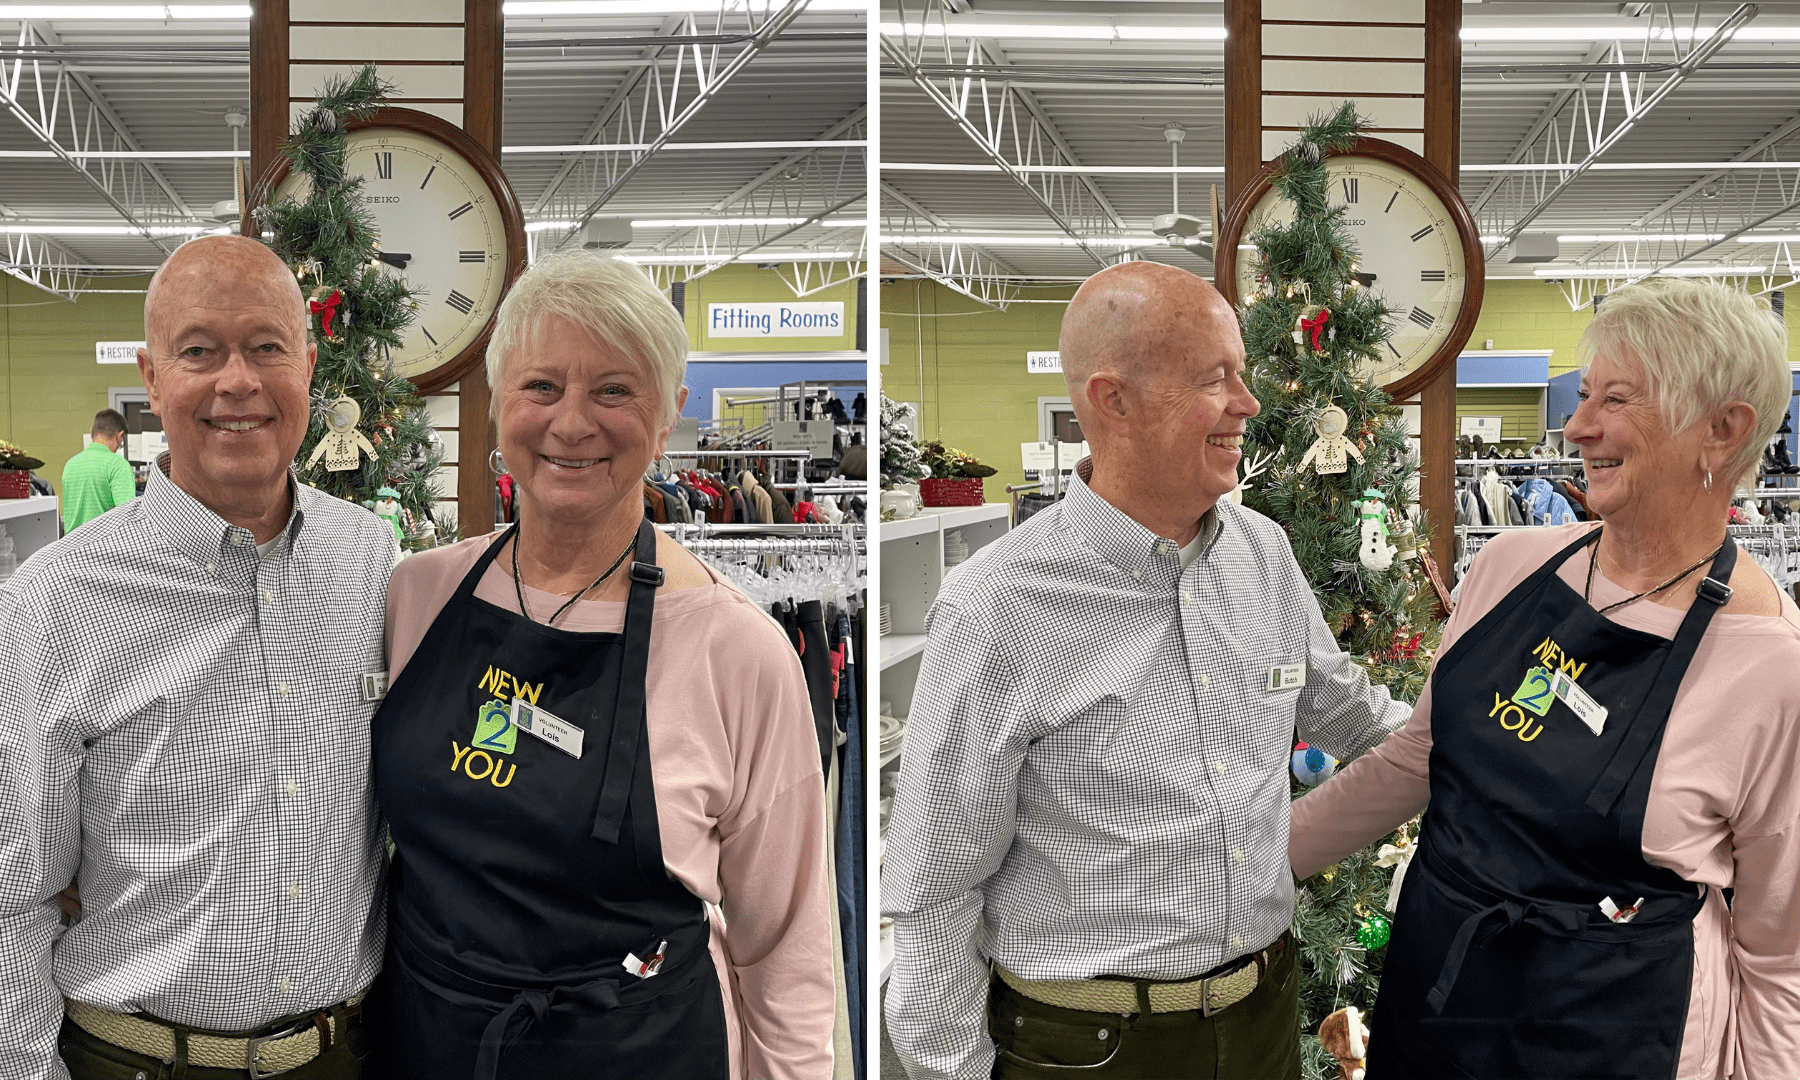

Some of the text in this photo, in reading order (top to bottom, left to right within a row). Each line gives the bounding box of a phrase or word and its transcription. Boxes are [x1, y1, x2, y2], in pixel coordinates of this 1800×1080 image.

[374, 151, 392, 180] XII
[366, 195, 400, 204] SEIKO
[1341, 219, 1366, 227] EIKO
[713, 307, 839, 335] Fitting Rooms
[107, 347, 137, 359] RESTRO
[1532, 636, 1588, 681] NEW
[478, 664, 544, 706] NEW
[1518, 675, 1551, 710] 2
[1488, 691, 1544, 742] YOU
[1573, 701, 1587, 718] Lois
[479, 709, 511, 749] 2
[538, 717, 568, 736] VOLUNTEER
[541, 727, 560, 743] Lois
[450, 740, 517, 788] YOU
